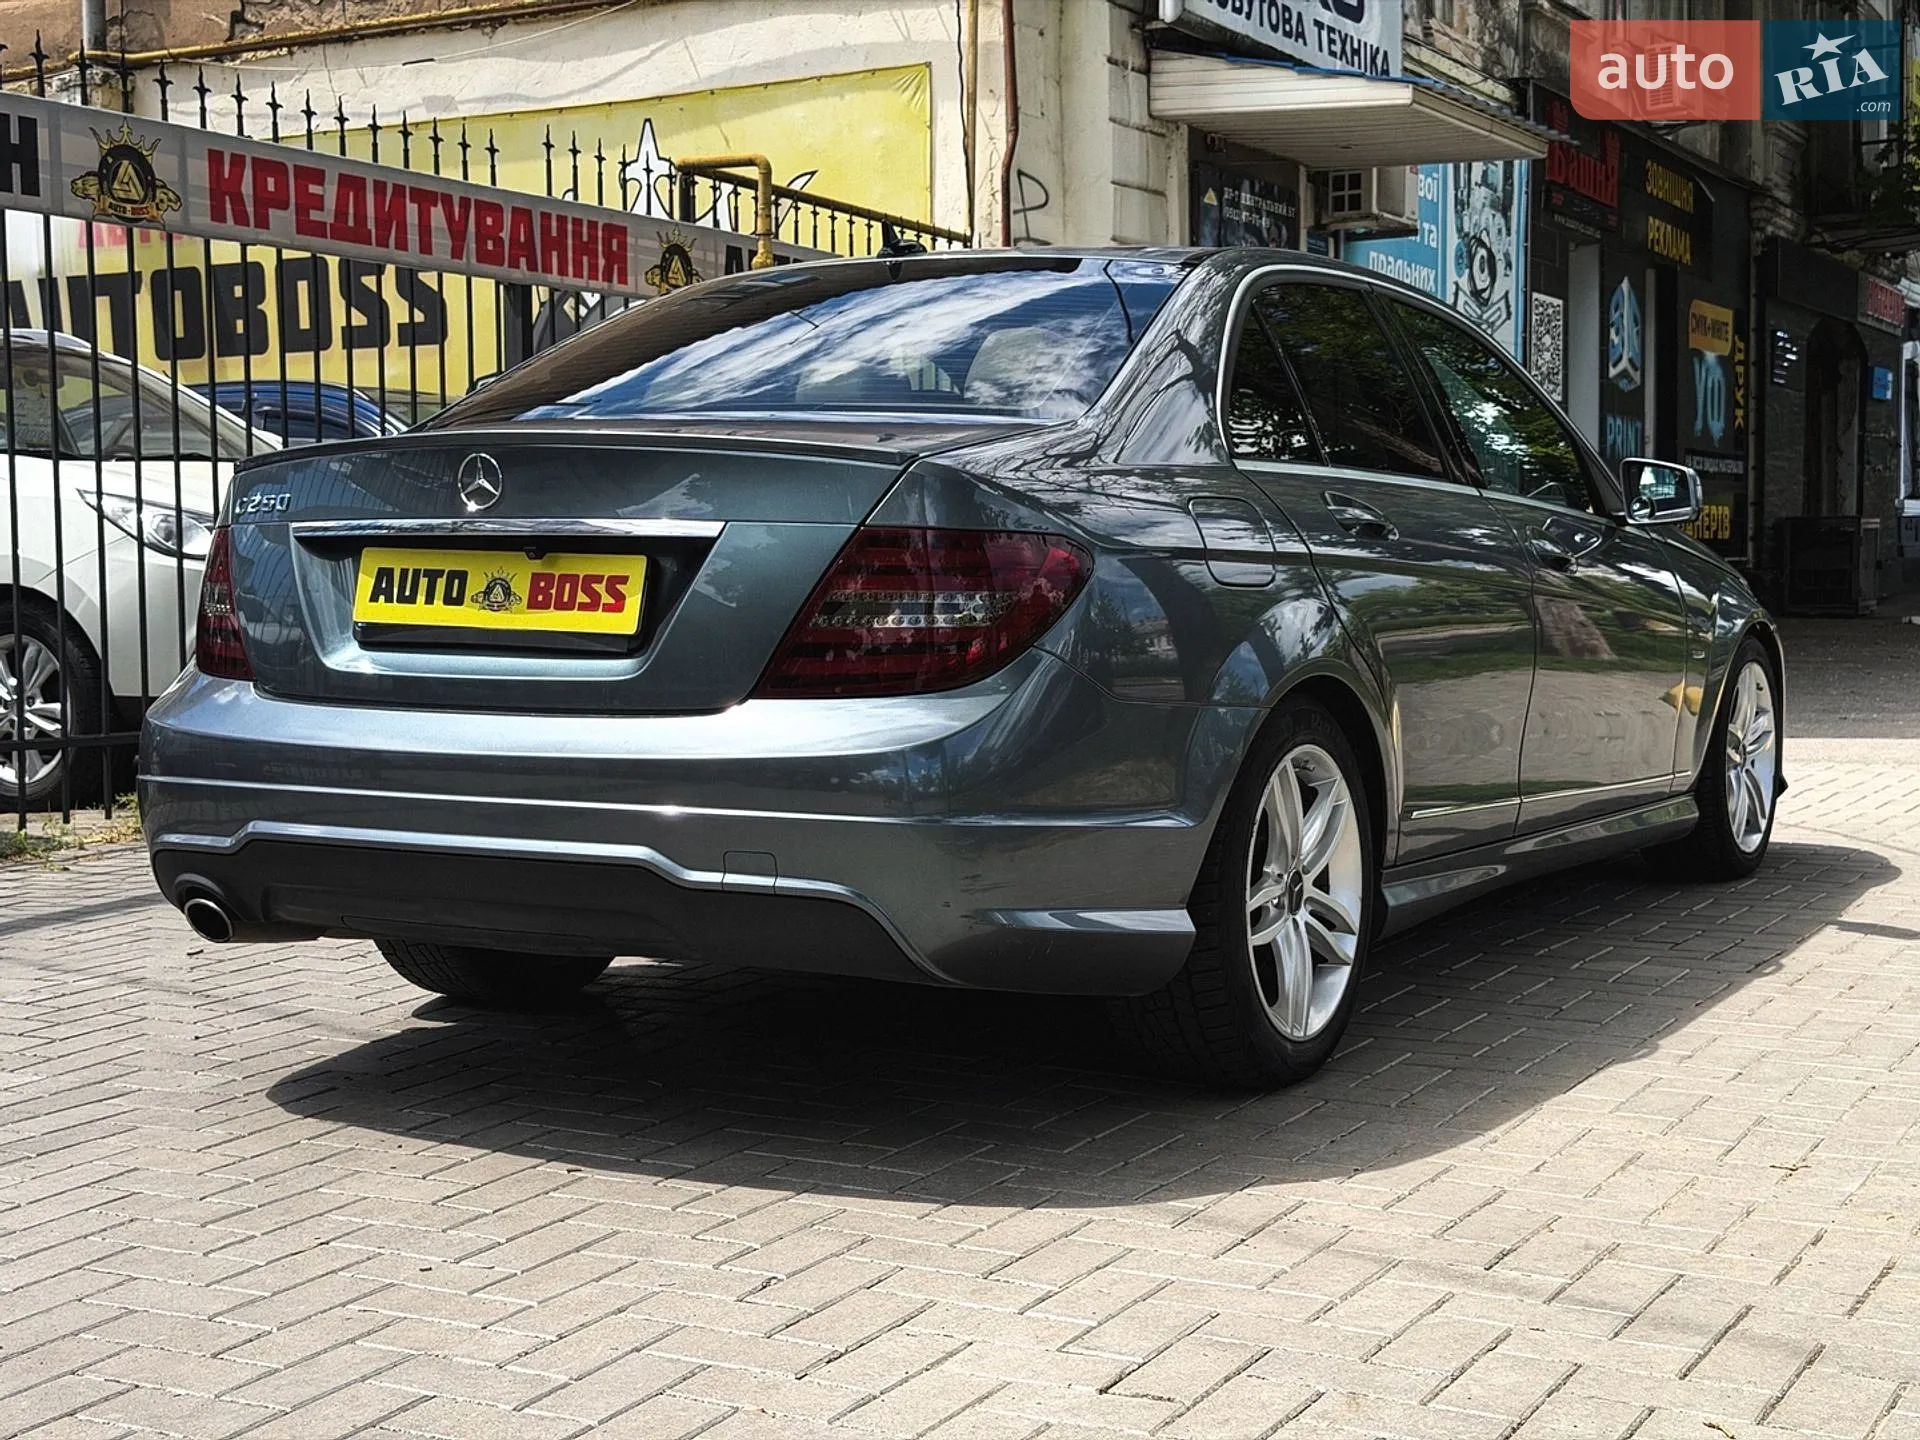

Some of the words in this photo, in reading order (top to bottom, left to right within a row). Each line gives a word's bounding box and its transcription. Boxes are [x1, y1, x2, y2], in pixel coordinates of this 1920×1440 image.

[1207, 0, 1307, 47] УТОВА
[1313, 18, 1391, 77] ТЕХНІКА
[207, 147, 628, 286] КРЕДИТУВАННЯ
[1422, 221, 1437, 248] та
[1647, 215, 1692, 266] РЕКЛАМА
[1677, 504, 1730, 539] НЕРІВ
[369, 566, 468, 607] AUTO
[526, 572, 630, 613] BOSS
